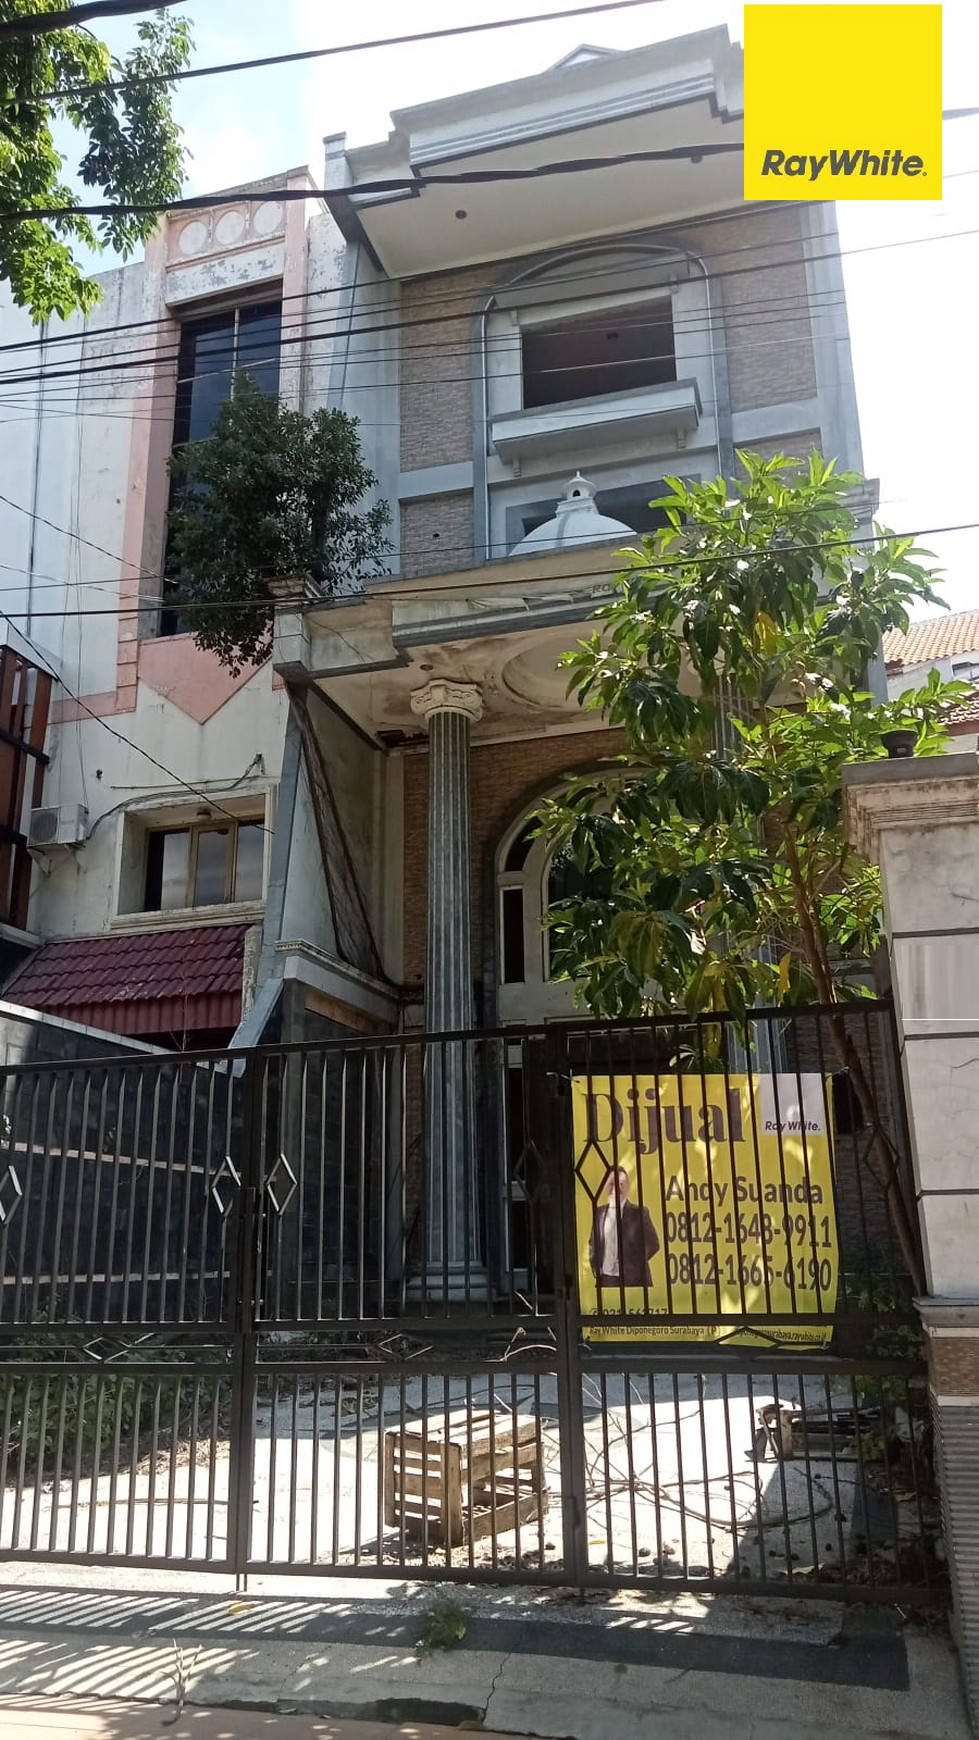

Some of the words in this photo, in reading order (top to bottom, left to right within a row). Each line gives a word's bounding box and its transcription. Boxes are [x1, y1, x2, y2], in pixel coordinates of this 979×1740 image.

[581, 1088, 746, 1155] Dijual
[765, 1121, 786, 1131] Ray
[666, 1175, 728, 1207] Andy
[735, 1176, 823, 1204] Suanda
[666, 1211, 832, 1248] 0812-1648-9911
[668, 1253, 832, 1291] 0812-1665-6190
